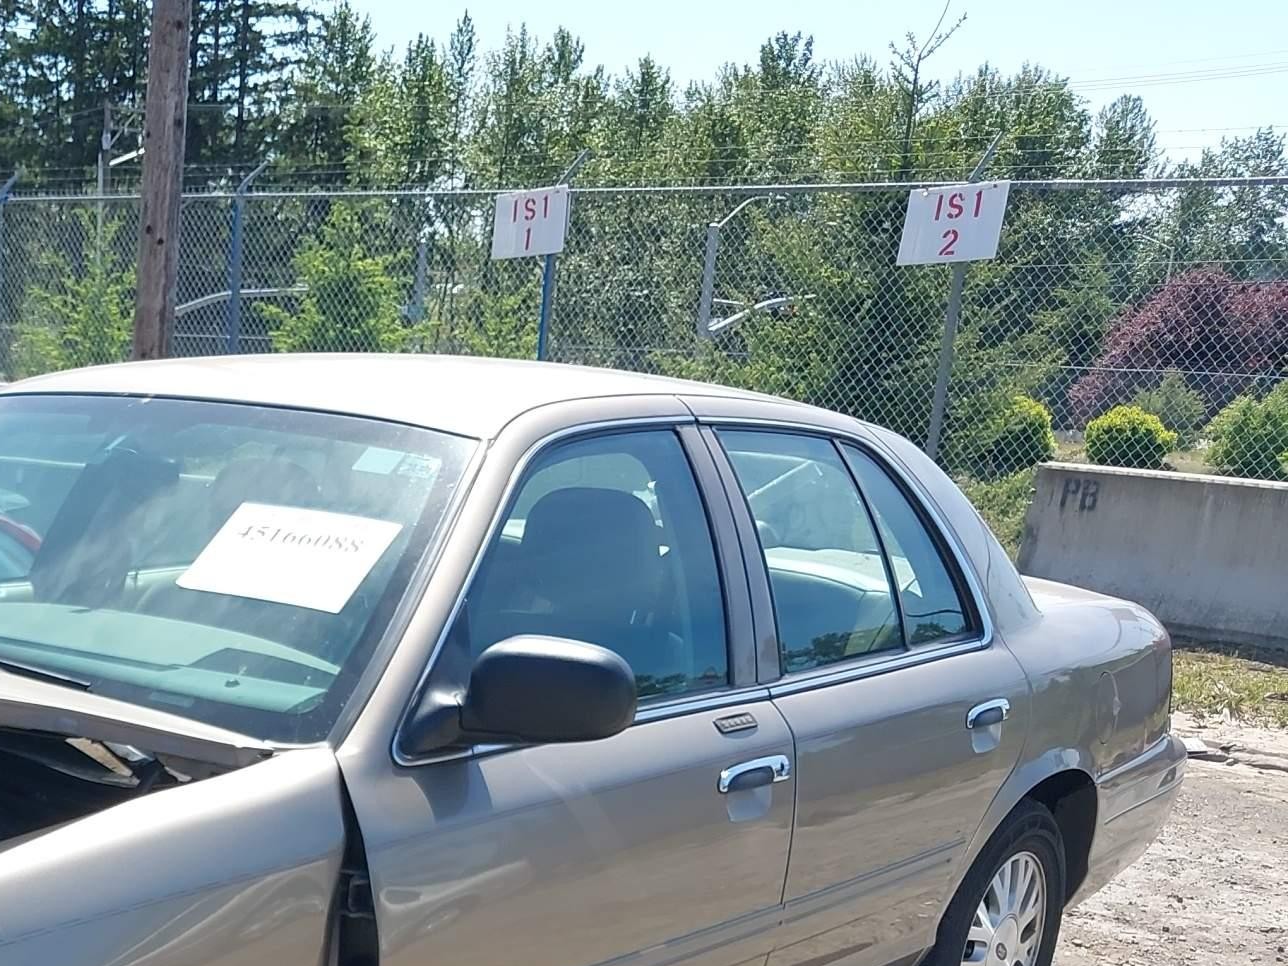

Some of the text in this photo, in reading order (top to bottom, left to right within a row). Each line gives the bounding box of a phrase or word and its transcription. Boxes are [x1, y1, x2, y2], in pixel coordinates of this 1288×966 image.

[524, 227, 532, 251] 1
[938, 229, 959, 256] 2
[1059, 477, 1102, 512] PB
[237, 525, 365, 553] 45166088
